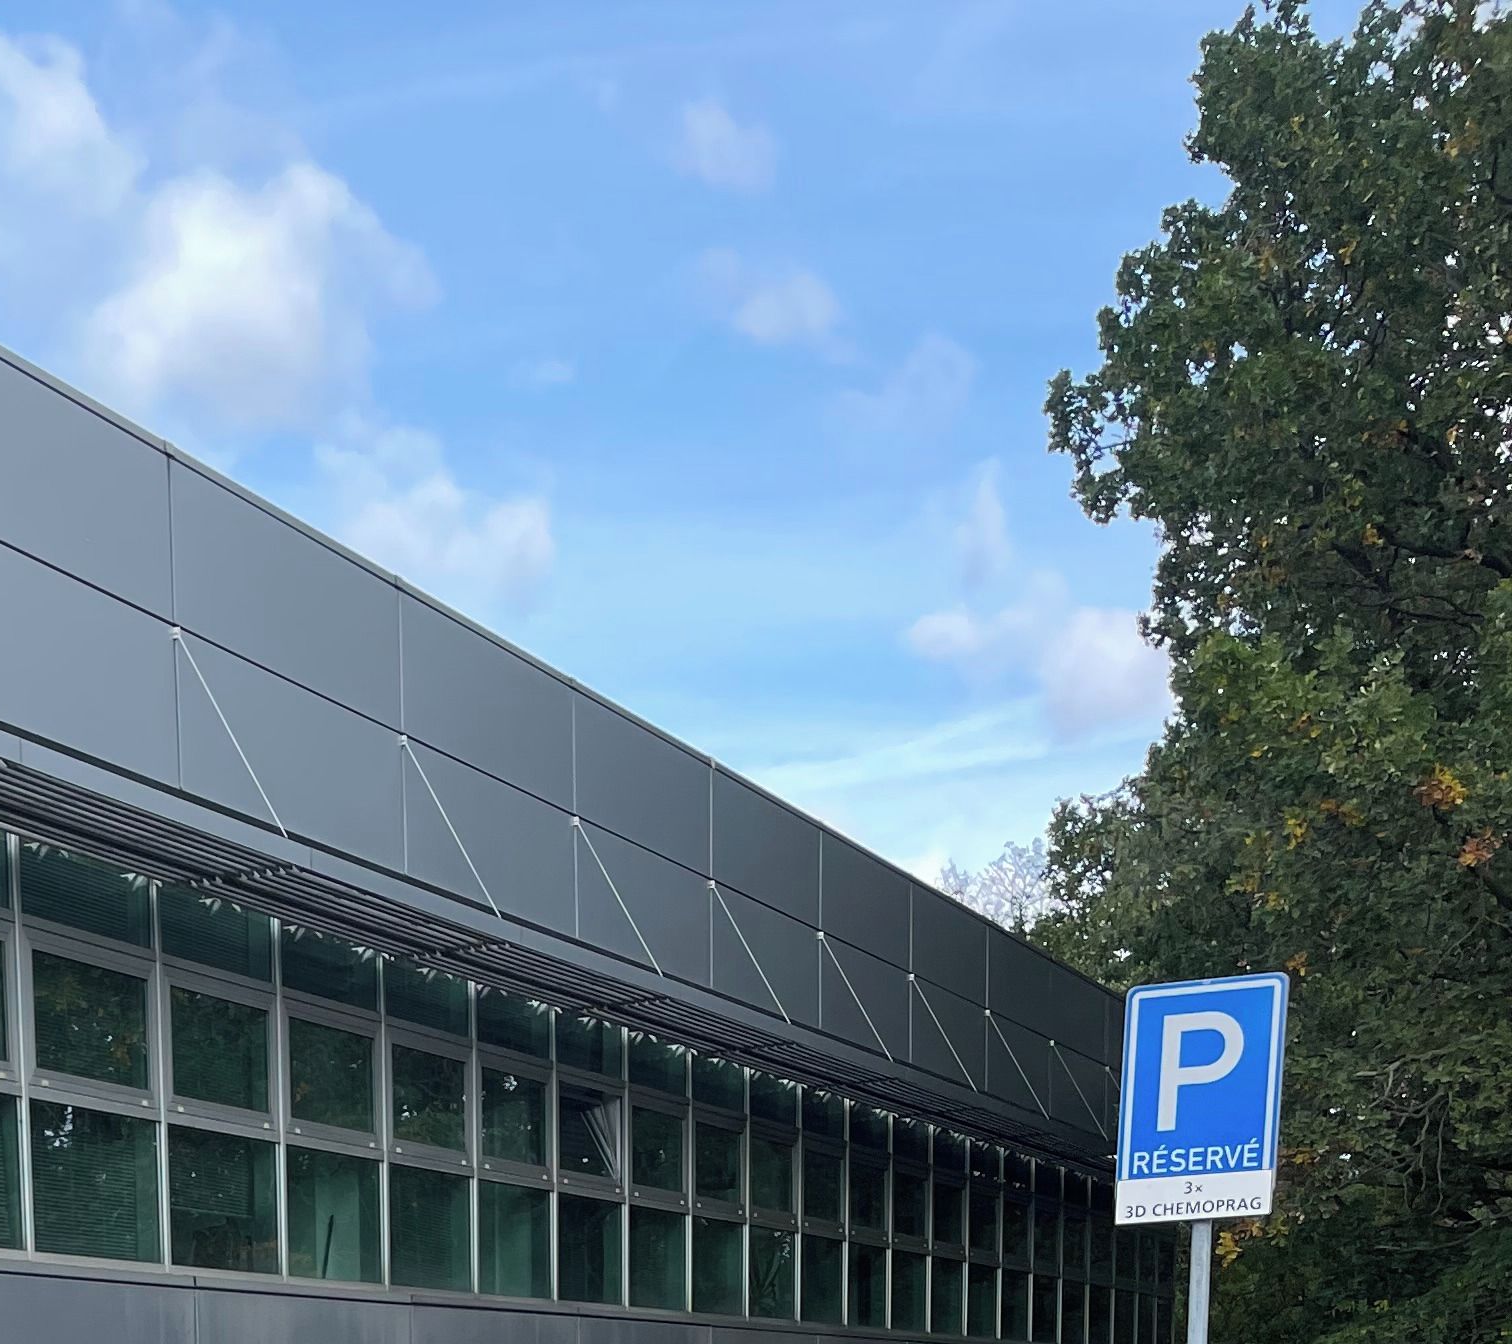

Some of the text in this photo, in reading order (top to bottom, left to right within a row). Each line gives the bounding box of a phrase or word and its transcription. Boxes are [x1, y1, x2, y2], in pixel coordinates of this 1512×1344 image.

[1156, 1011, 1245, 1132] P
[1132, 1137, 1260, 1175] RÉSERVÉ
[1125, 1196, 1262, 1218] 3D CHEMOPRAG
